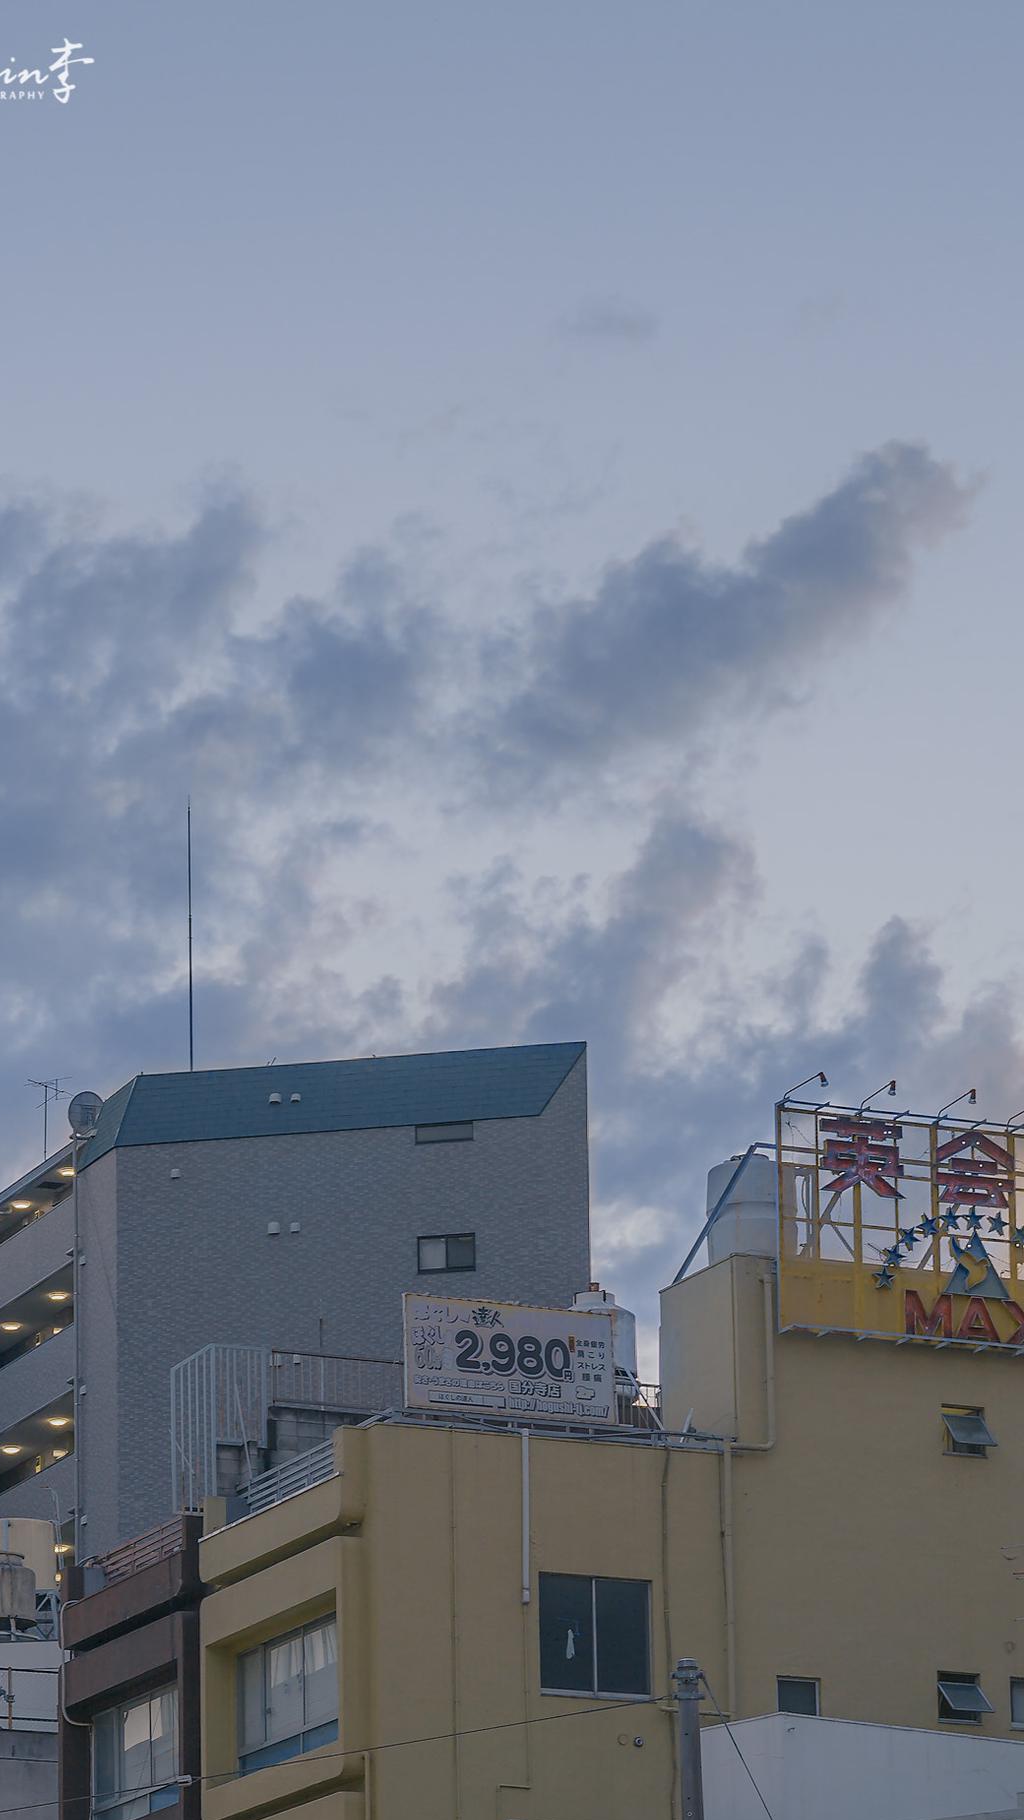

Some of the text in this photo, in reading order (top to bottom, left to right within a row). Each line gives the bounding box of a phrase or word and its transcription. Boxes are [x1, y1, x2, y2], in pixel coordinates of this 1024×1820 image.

[577, 1361, 606, 1371] ストレス
[508, 1380, 562, 1398] 国分寺店
